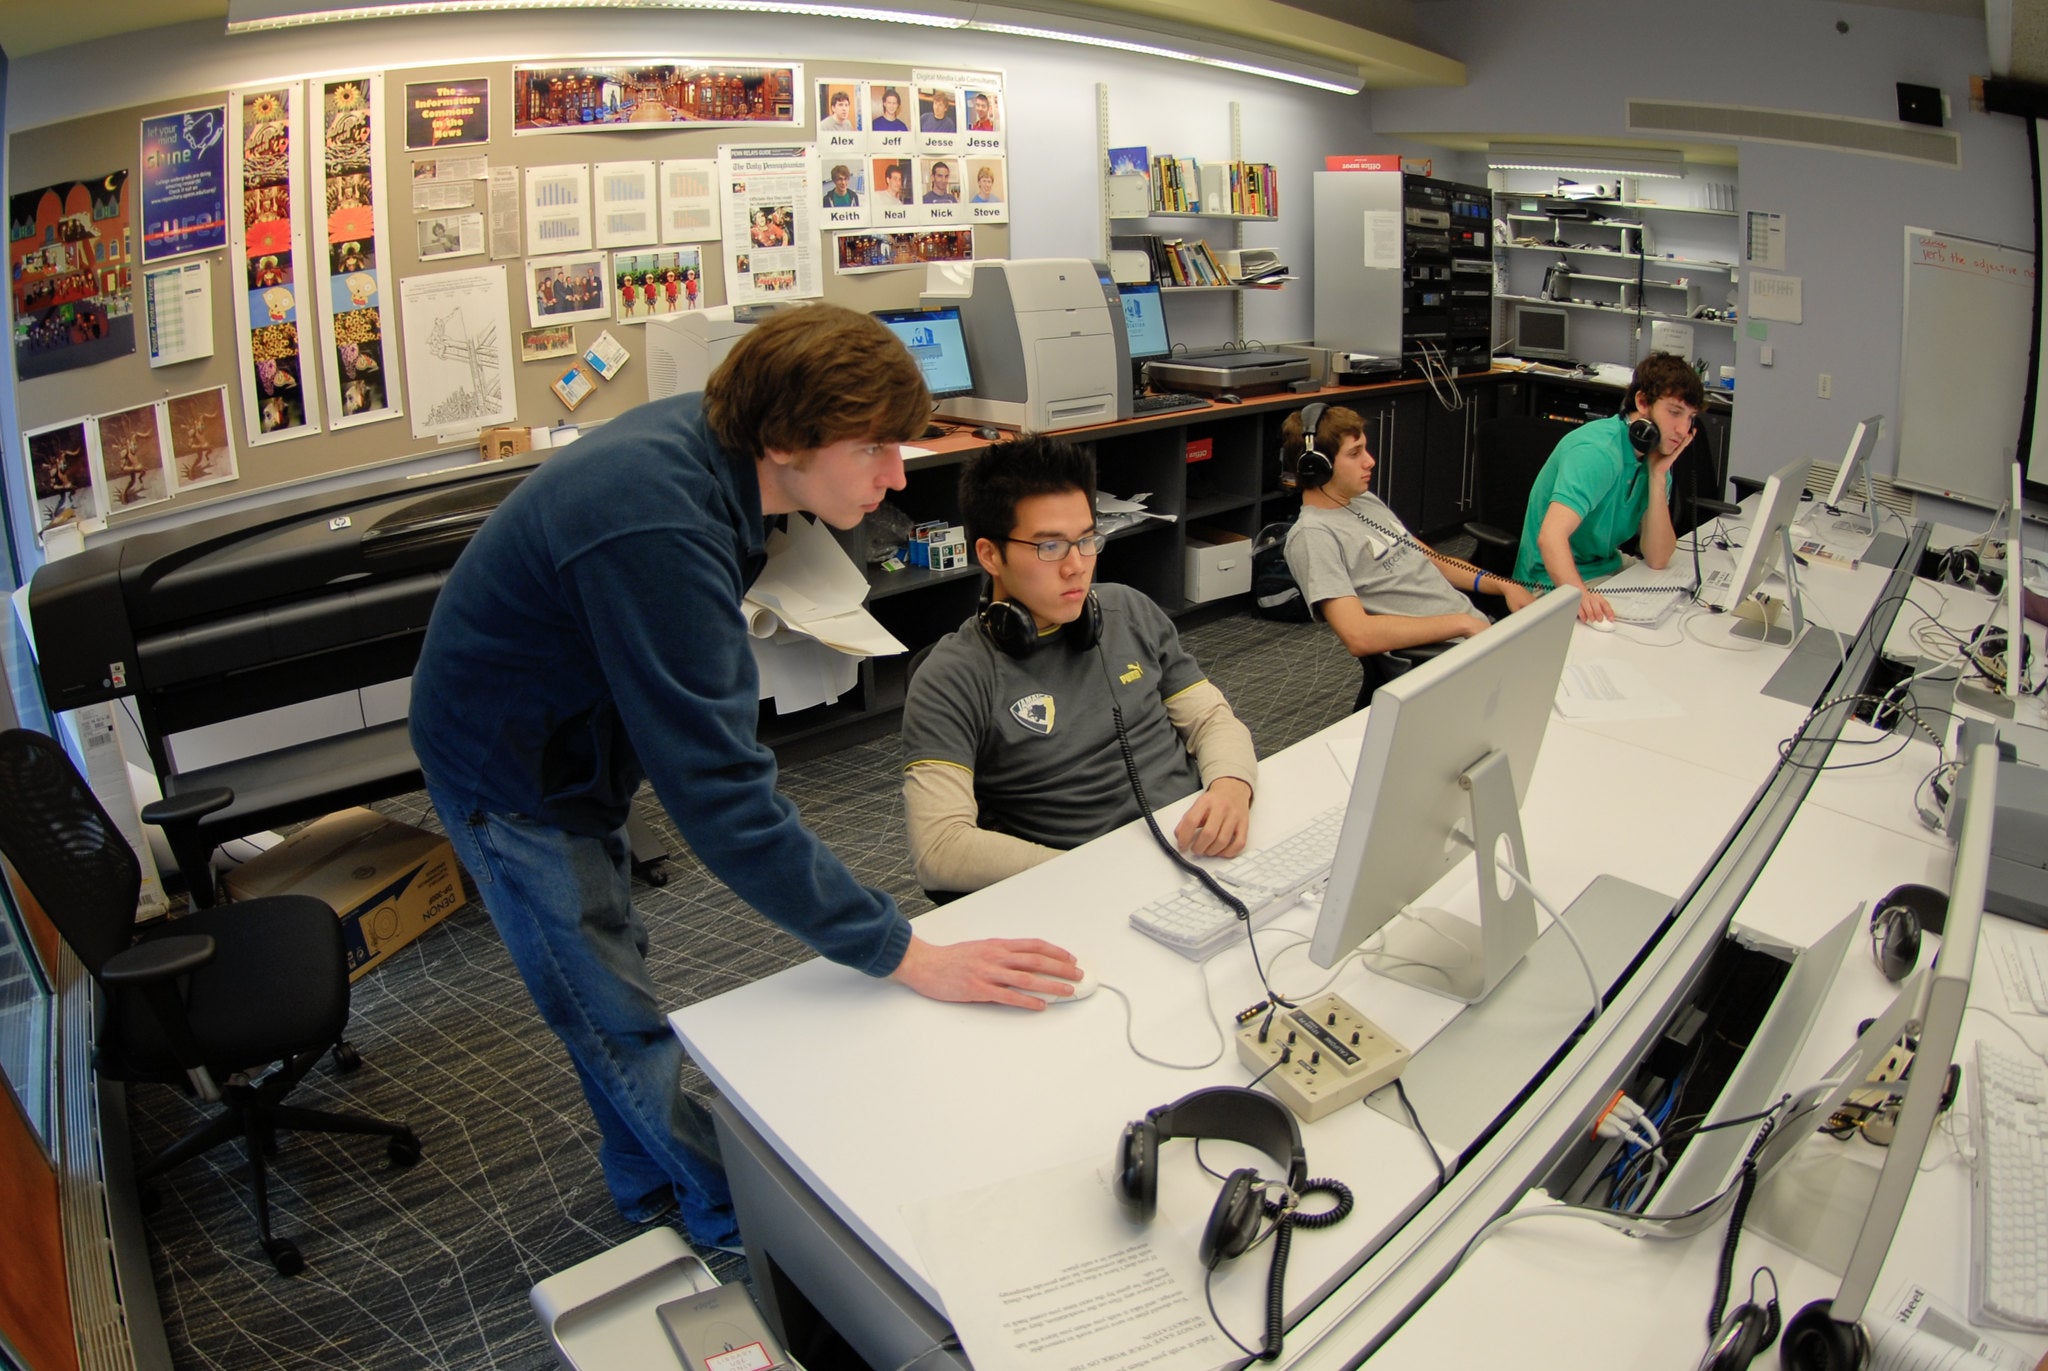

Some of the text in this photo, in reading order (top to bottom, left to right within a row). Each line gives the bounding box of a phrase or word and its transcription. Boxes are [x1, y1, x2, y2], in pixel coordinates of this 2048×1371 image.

[916, 72, 936, 82] Digital
[436, 88, 456, 96] The
[415, 96, 480, 108] Information
[422, 108, 474, 118] Commons
[446, 118, 464, 127] the
[147, 124, 178, 137] let your
[434, 128, 462, 138] News
[158, 134, 178, 144] mind
[830, 136, 854, 146] Alex
[882, 136, 902, 146] Jeff
[925, 137, 954, 146] Jesse
[966, 137, 1000, 148] Jesse
[147, 148, 192, 168] shine
[1361, 162, 1381, 170] Office
[830, 211, 860, 222] Keith
[884, 210, 906, 220] Neal
[931, 209, 952, 218] Nick
[974, 208, 1000, 217] Steve
[1951, 252, 1965, 265] the
[422, 892, 456, 922] DENON
